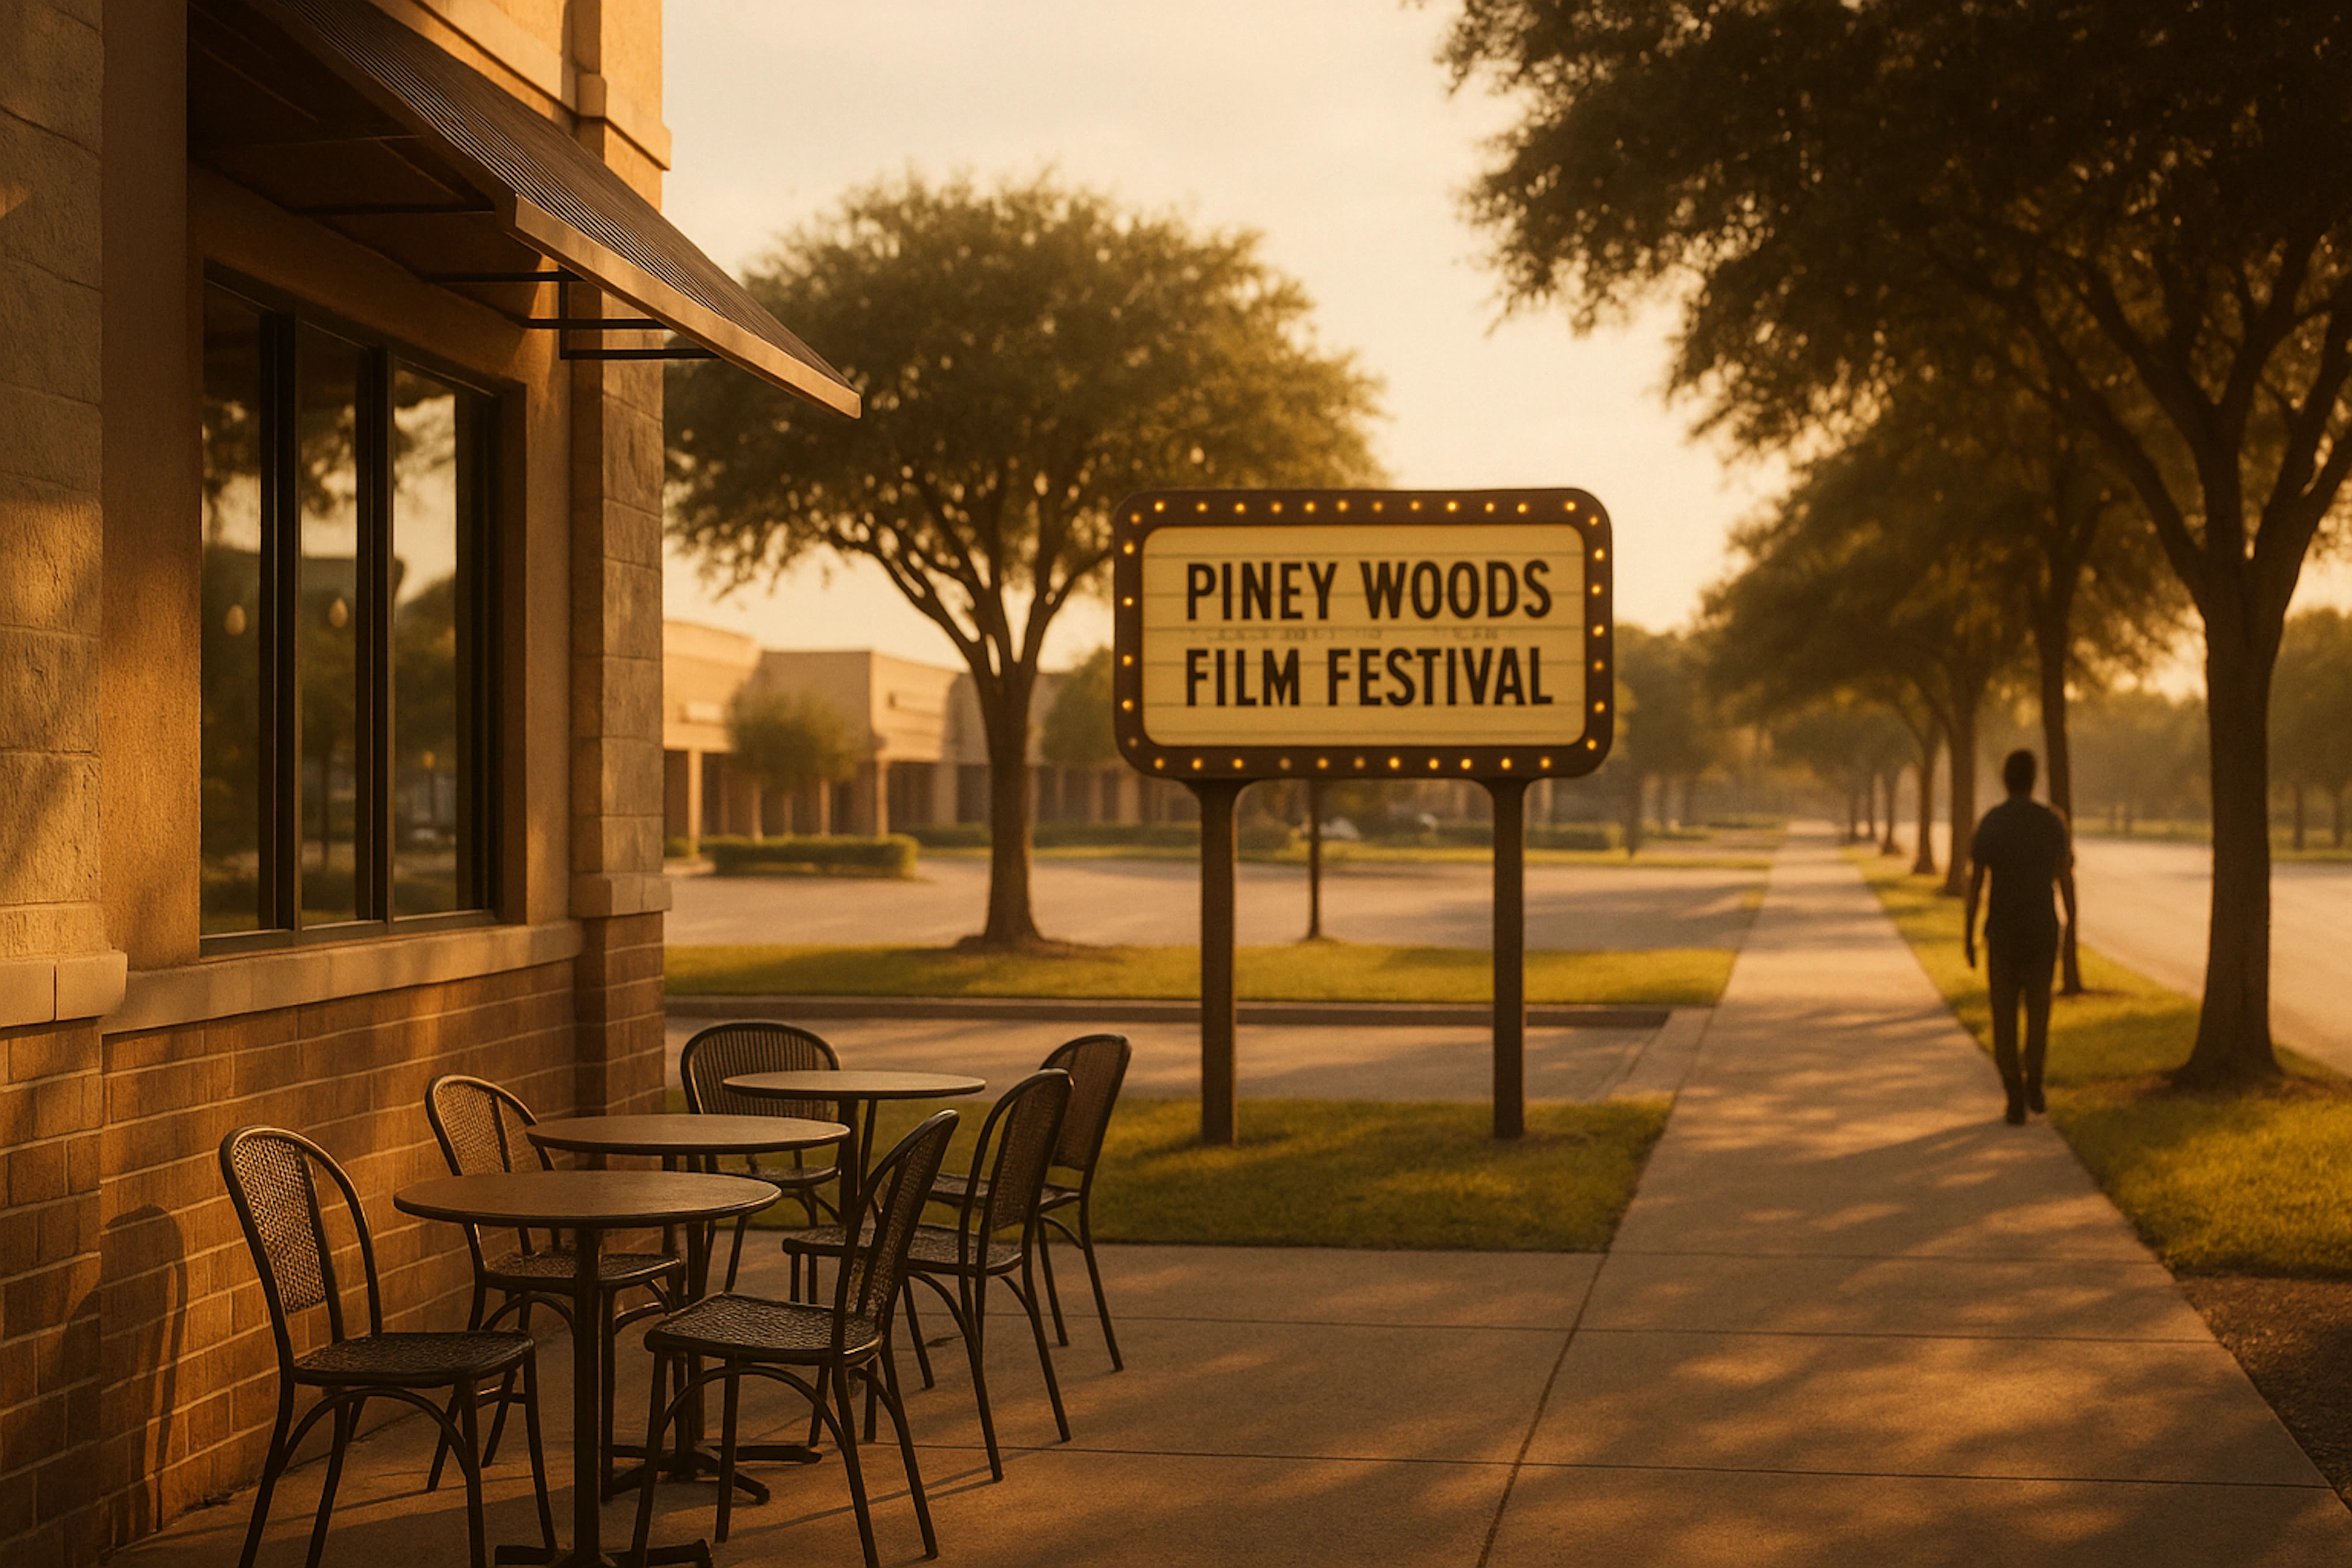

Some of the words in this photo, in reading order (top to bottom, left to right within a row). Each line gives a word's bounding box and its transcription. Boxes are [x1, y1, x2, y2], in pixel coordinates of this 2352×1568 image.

[1186, 561, 1338, 621] PINEY
[1359, 559, 1552, 620] WOODS
[1186, 648, 1300, 707] FILM
[1327, 647, 1554, 707] FESTIVAL
